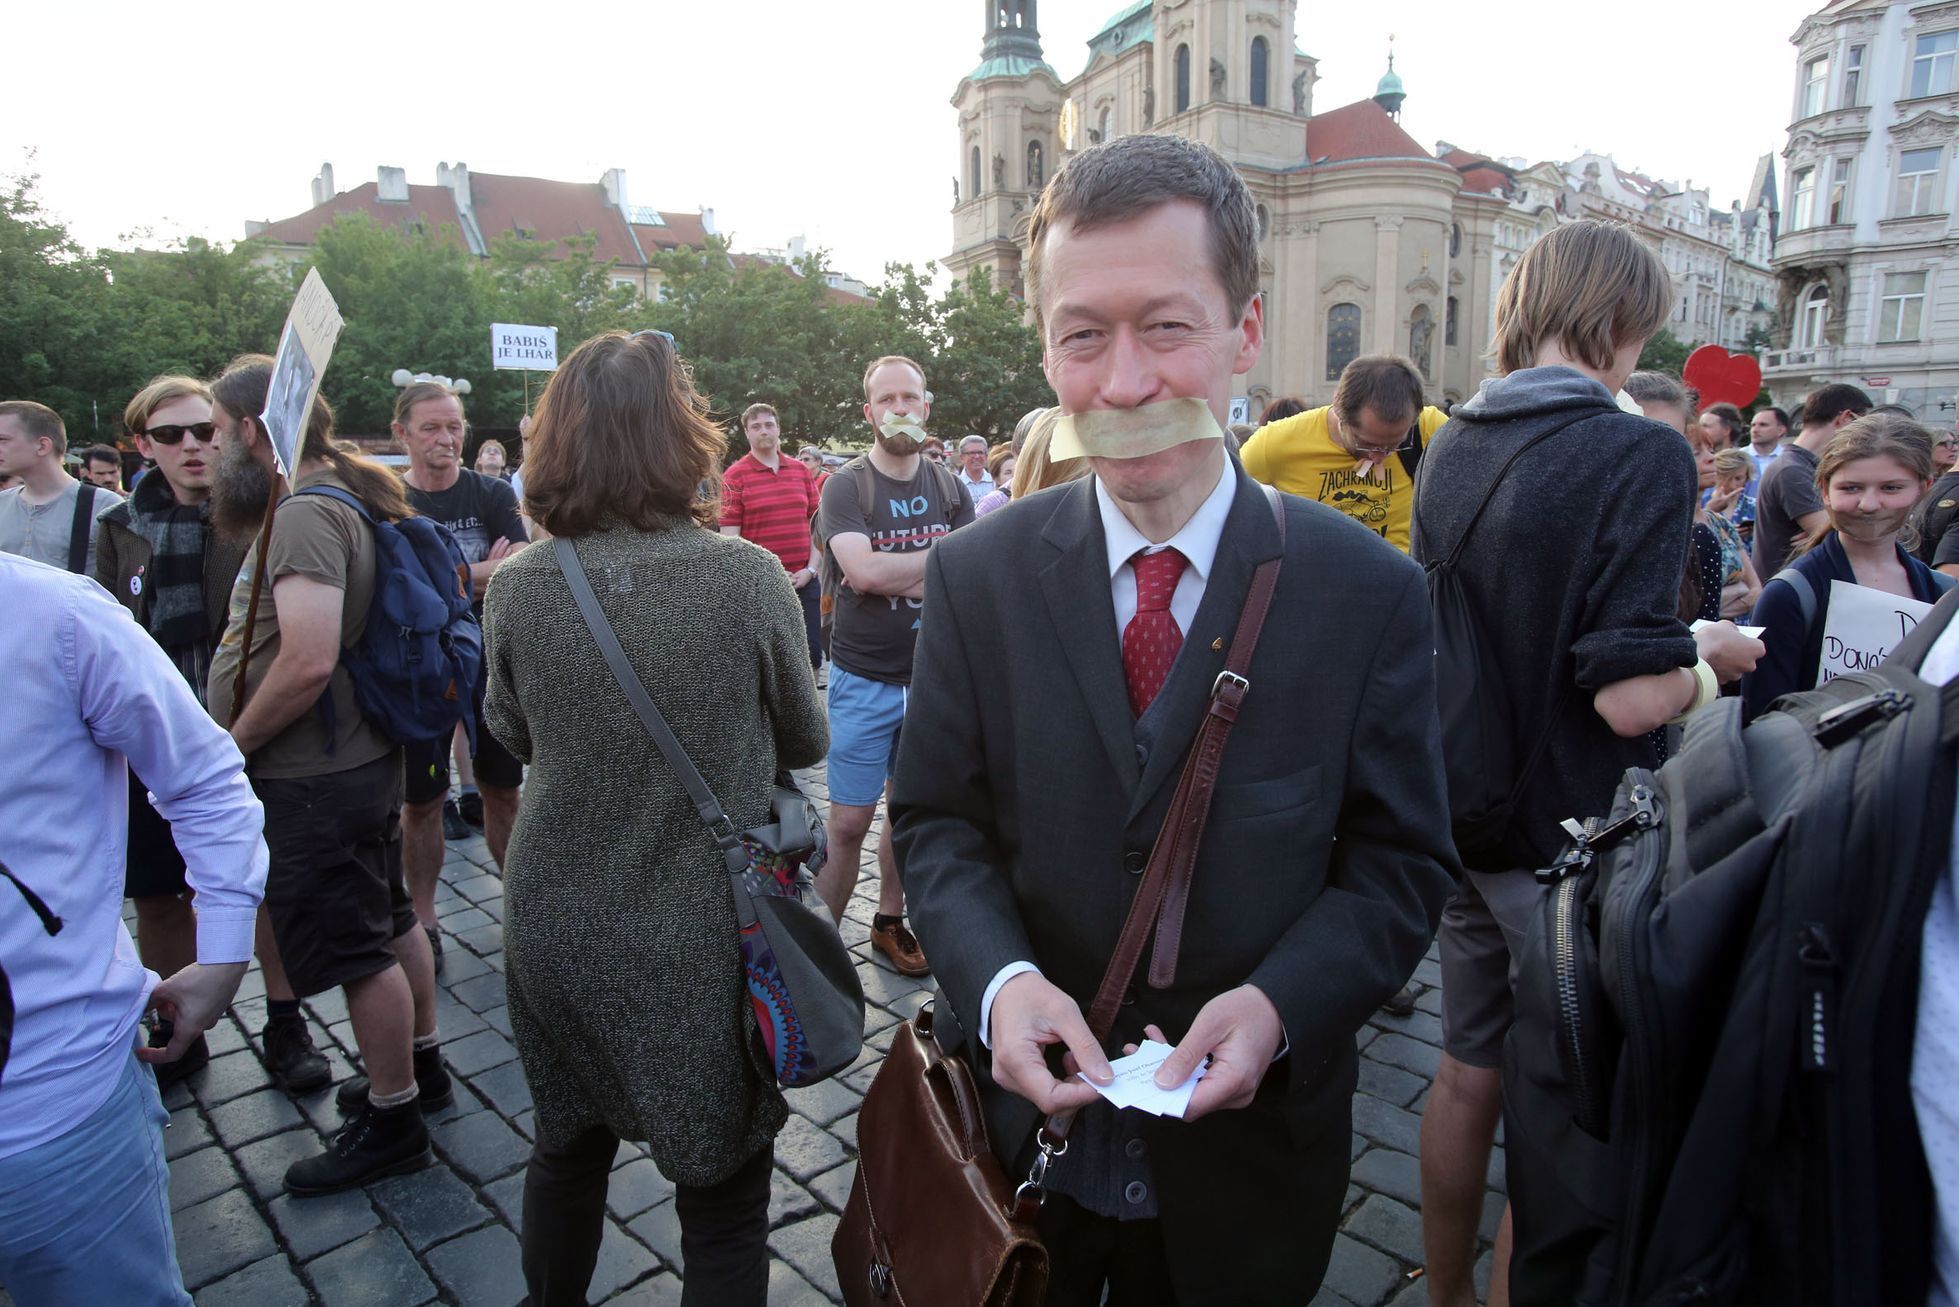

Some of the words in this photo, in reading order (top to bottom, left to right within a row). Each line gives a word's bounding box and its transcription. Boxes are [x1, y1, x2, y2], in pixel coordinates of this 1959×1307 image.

[502, 335, 548, 348] BABIŠ
[498, 347, 512, 359] JE
[889, 495, 929, 518] NO
